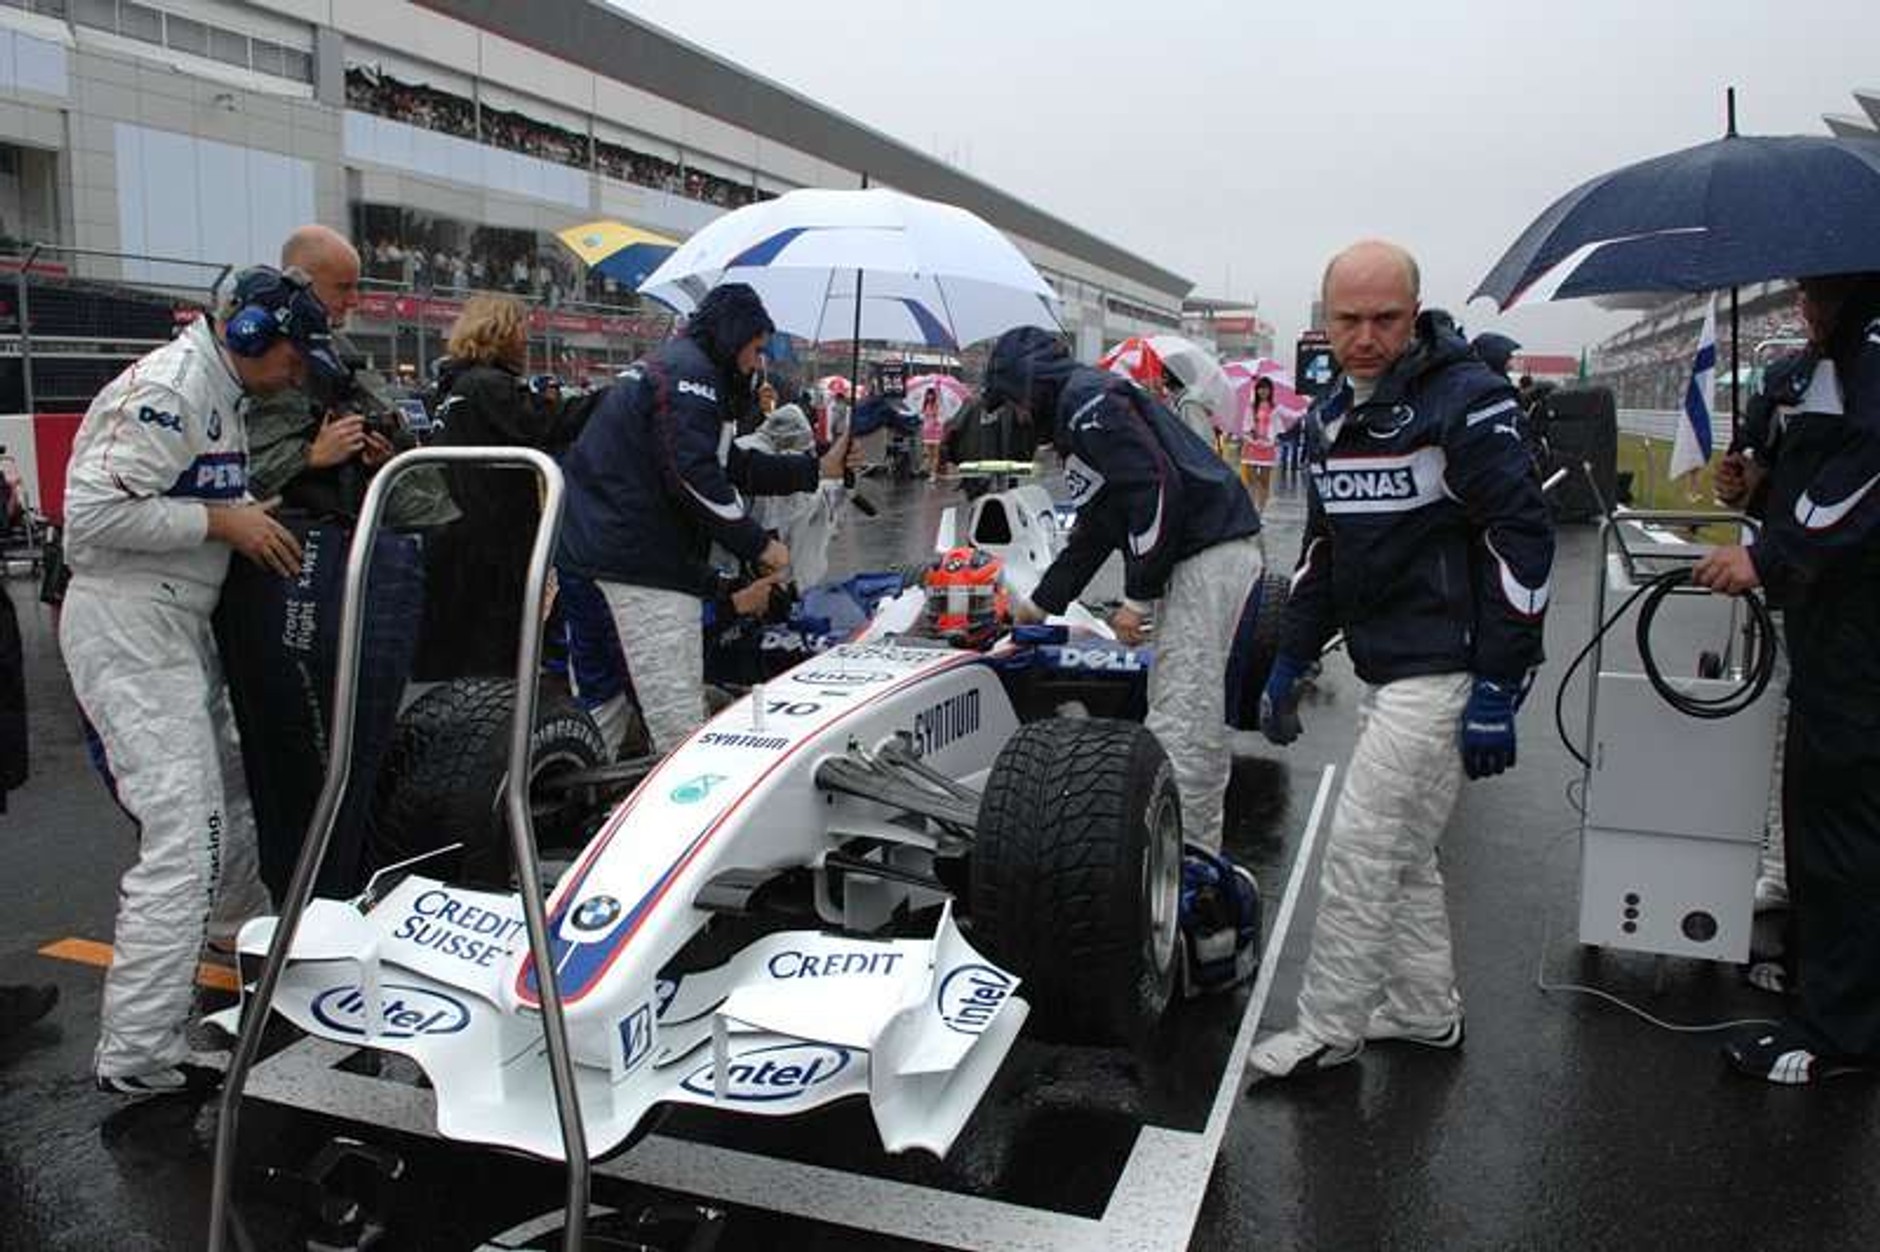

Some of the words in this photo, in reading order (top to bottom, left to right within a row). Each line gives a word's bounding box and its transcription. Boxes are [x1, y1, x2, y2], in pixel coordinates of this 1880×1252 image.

[678, 380, 717, 401] DELL
[1059, 648, 1141, 671] DELL
[766, 700, 822, 716] 10
[914, 688, 979, 754] SYNTIUM
[413, 890, 526, 941] CREDIT
[394, 915, 503, 967] SUISSE
[768, 951, 904, 979] CREDIT
[943, 976, 1009, 1026] intel
[706, 1057, 824, 1086] ntel
